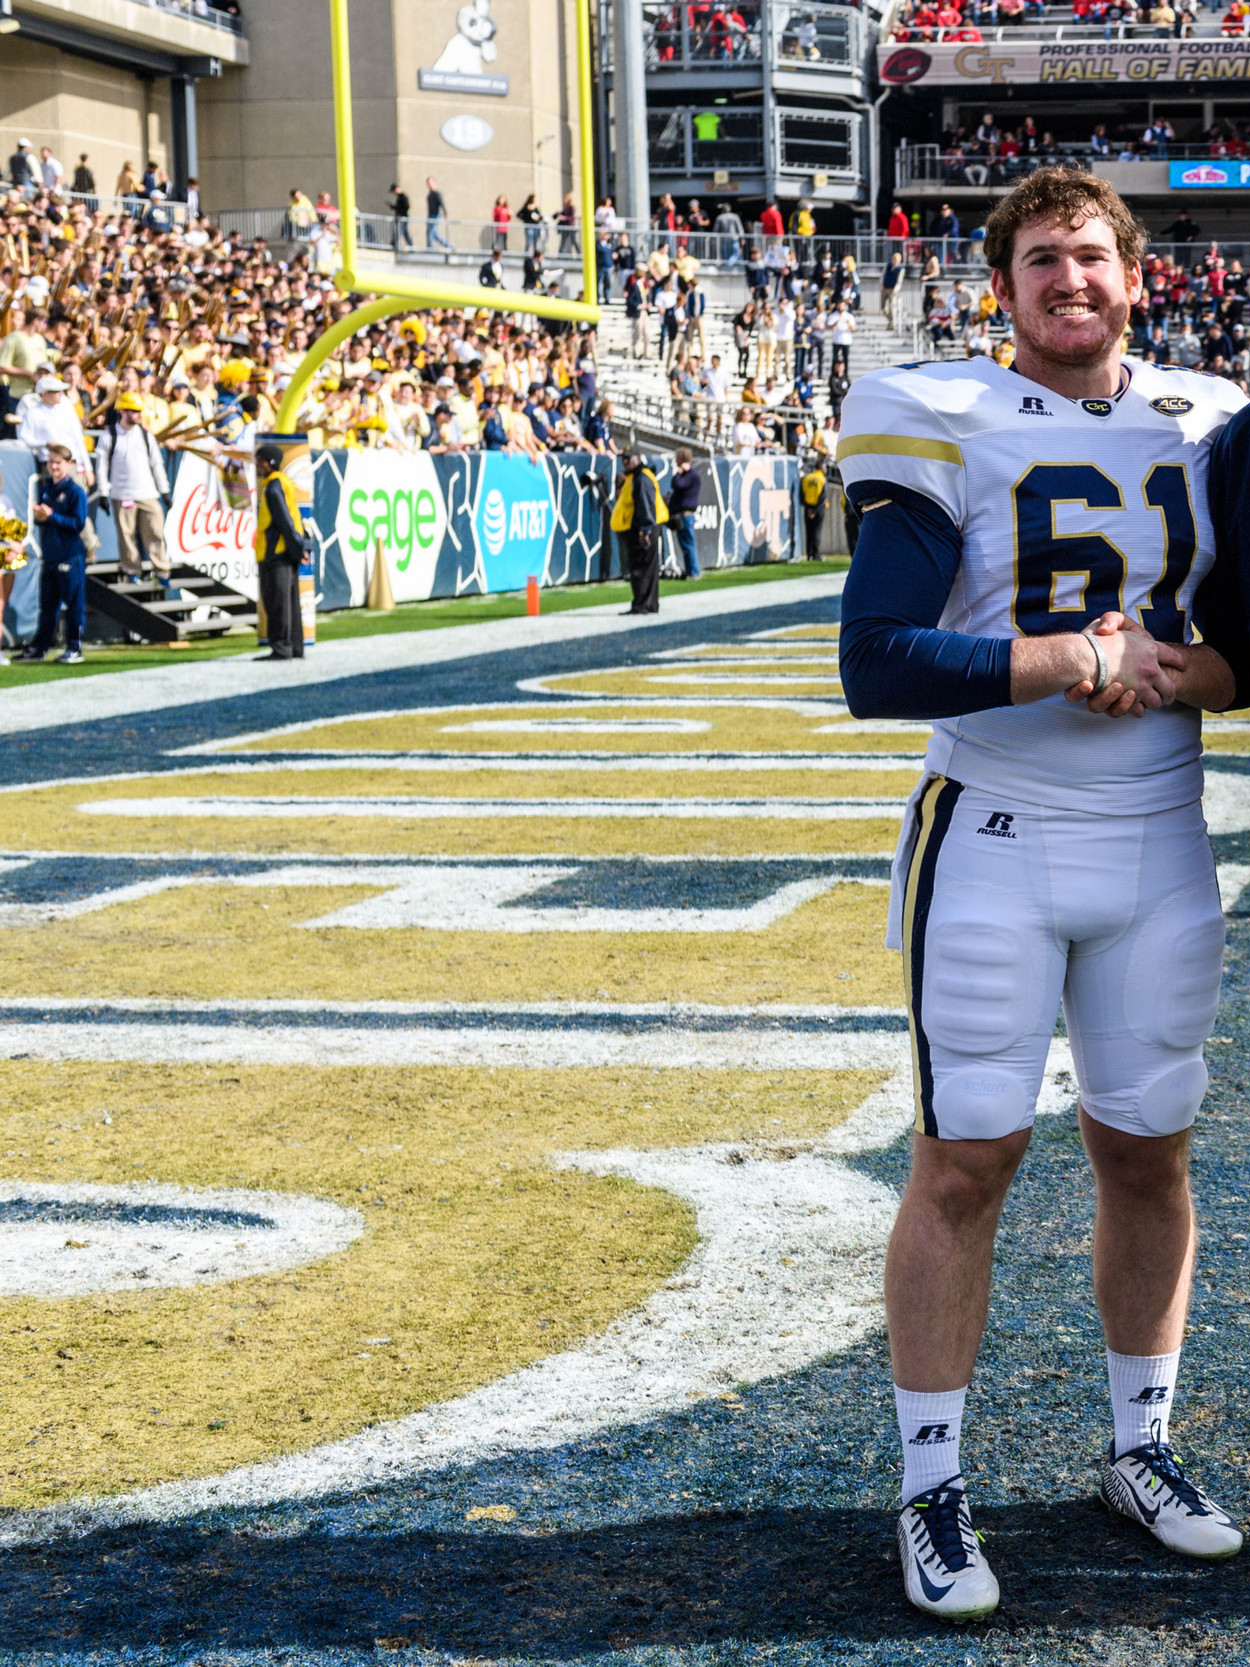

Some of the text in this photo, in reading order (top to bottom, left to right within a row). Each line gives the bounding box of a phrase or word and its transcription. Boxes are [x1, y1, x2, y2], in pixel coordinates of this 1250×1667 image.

[1040, 42, 1171, 56] PROFESSIONAL
[1040, 58, 1120, 82] HALL
[1126, 57, 1171, 80] OF
[1018, 408, 1054, 416] RUSSELL
[1157, 399, 1188, 409] ACC
[509, 500, 549, 541] AT&T
[693, 505, 717, 529] SAN
[348, 488, 437, 572] sage
[1010, 461, 1203, 648] 61
[192, 562, 228, 580] ero
[976, 827, 1018, 839] RUSSELL
[908, 1435, 956, 1446] RUSSELL
